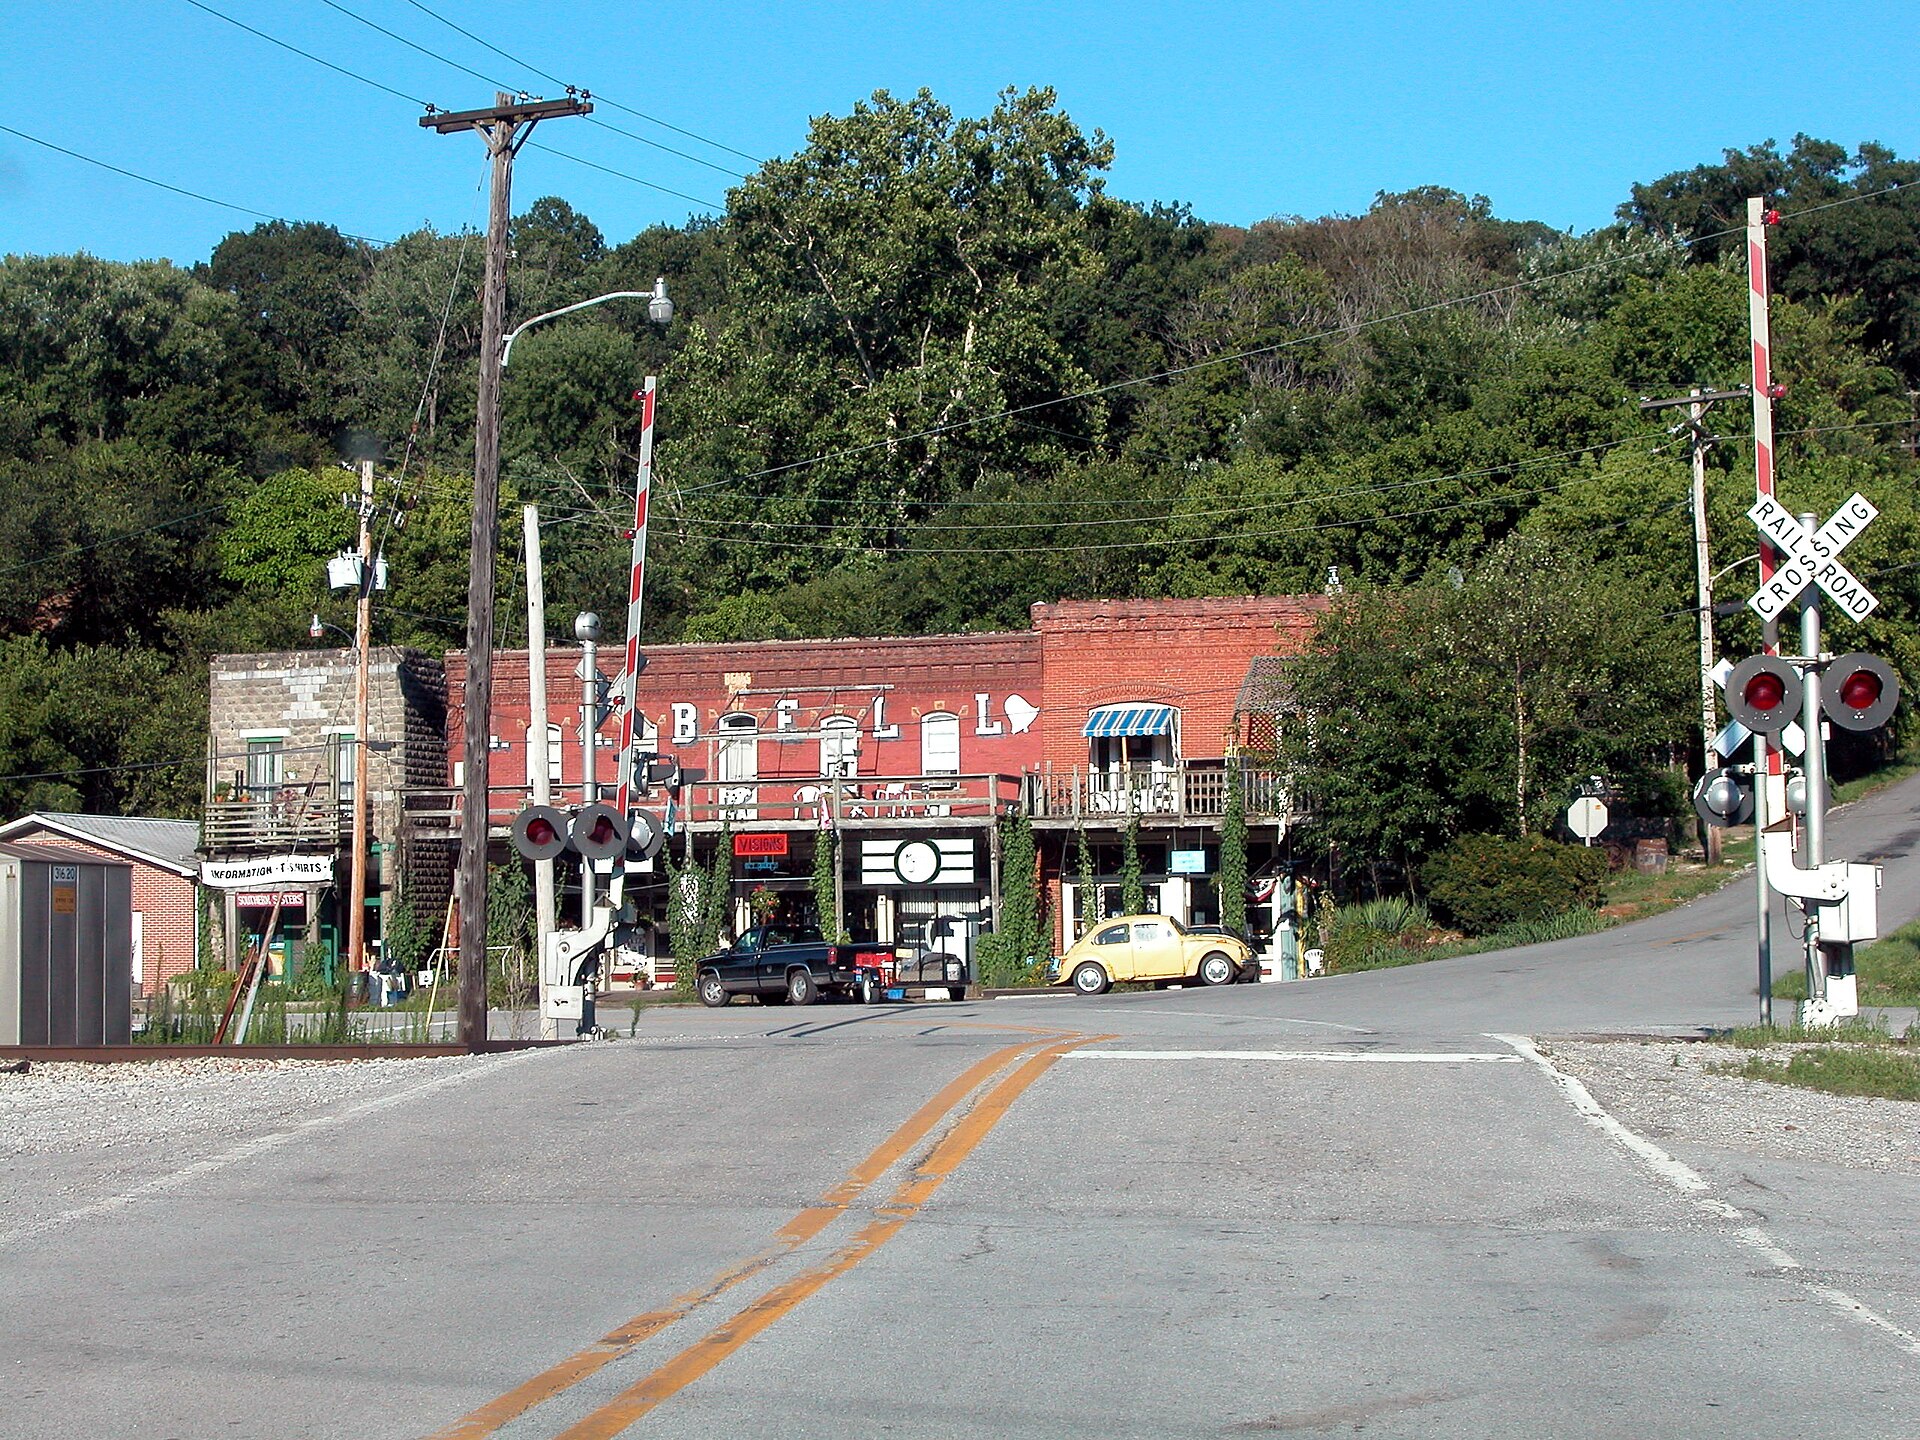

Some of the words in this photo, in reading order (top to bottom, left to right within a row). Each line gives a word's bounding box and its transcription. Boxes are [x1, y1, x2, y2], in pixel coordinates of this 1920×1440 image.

[1757, 503, 1868, 613] CROSSING
[739, 838, 784, 851] VISIONS
[211, 866, 272, 879] INFORMATION
[237, 895, 271, 905] SOUTHERN
[272, 895, 303, 905] SSTERS
